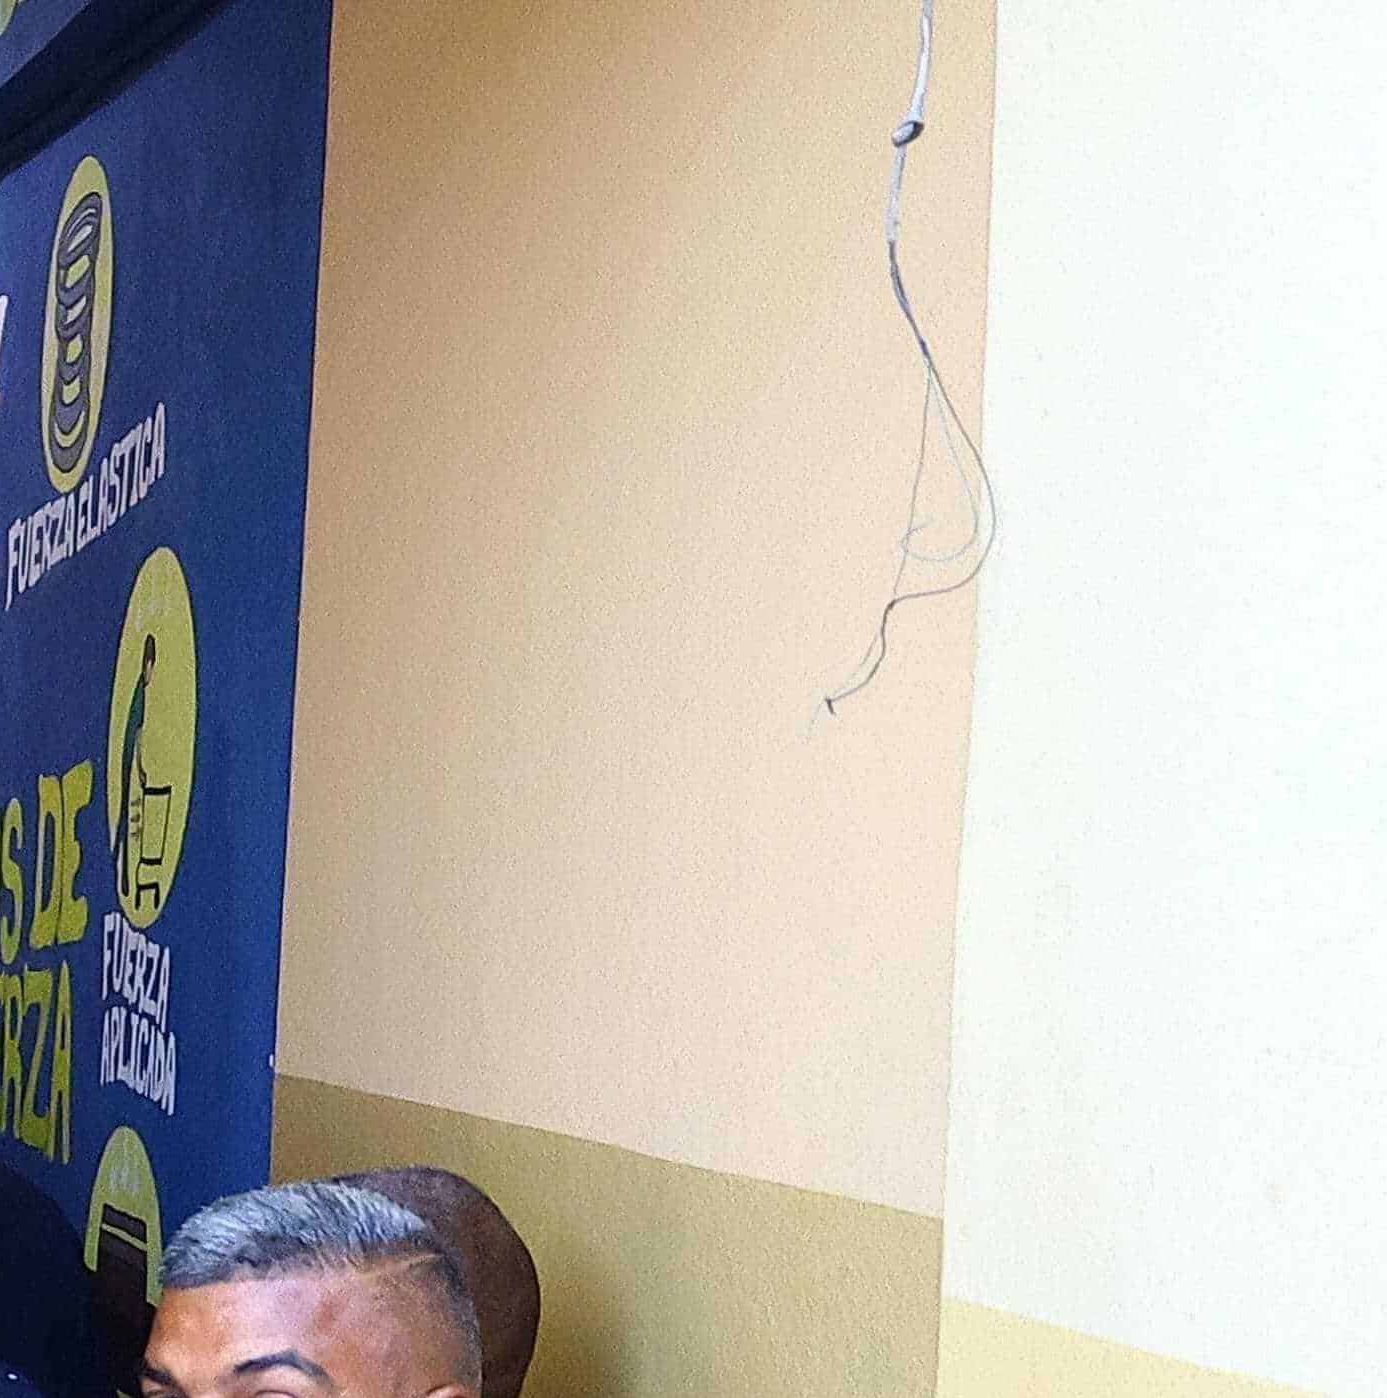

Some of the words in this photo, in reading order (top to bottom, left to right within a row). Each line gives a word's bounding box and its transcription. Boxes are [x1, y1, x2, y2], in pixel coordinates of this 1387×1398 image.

[5, 493, 75, 612] FUERZA
[76, 402, 166, 553] ELASTICA
[30, 759, 93, 950] DE
[102, 911, 170, 1033] FUERZA
[100, 1005, 176, 1116] APLICADA
